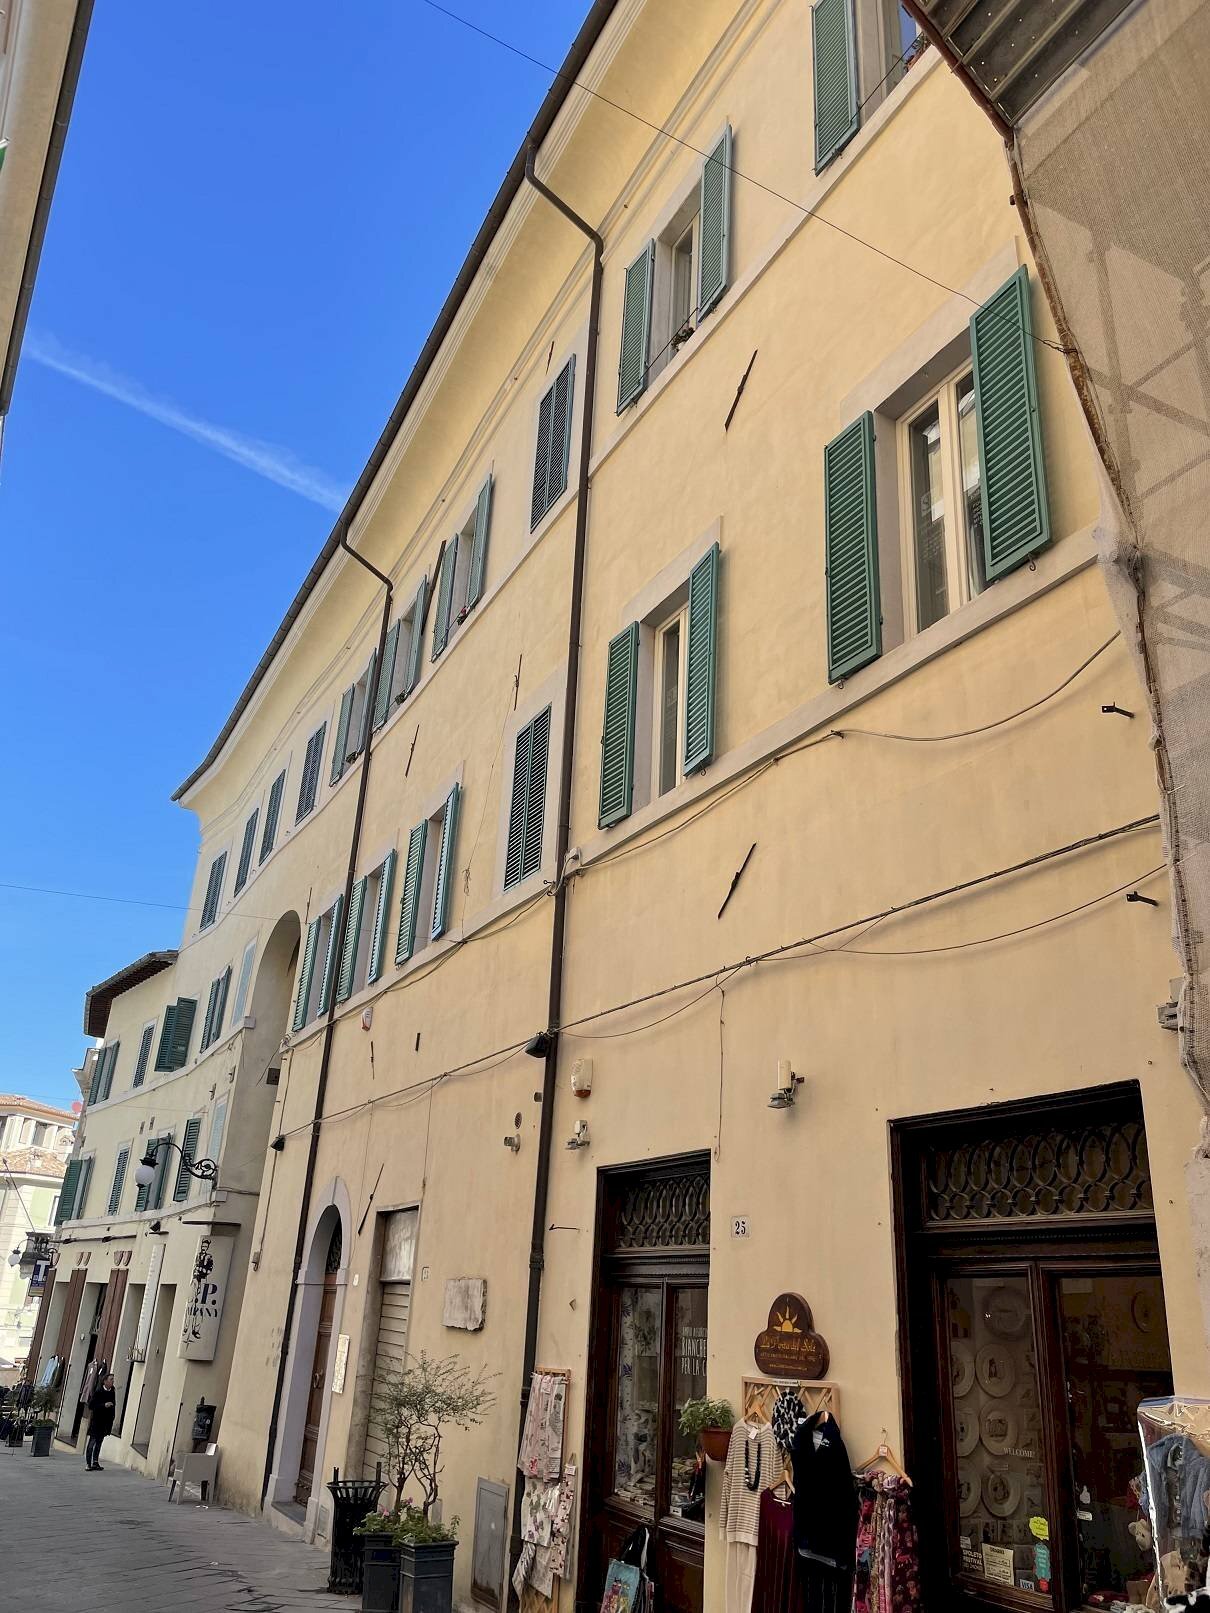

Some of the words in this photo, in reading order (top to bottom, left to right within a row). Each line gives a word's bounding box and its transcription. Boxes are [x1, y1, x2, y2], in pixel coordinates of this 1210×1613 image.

[734, 1220, 746, 1235] 25
[37, 1260, 50, 1281] T
[1021, 1582, 1034, 1591] VISA
